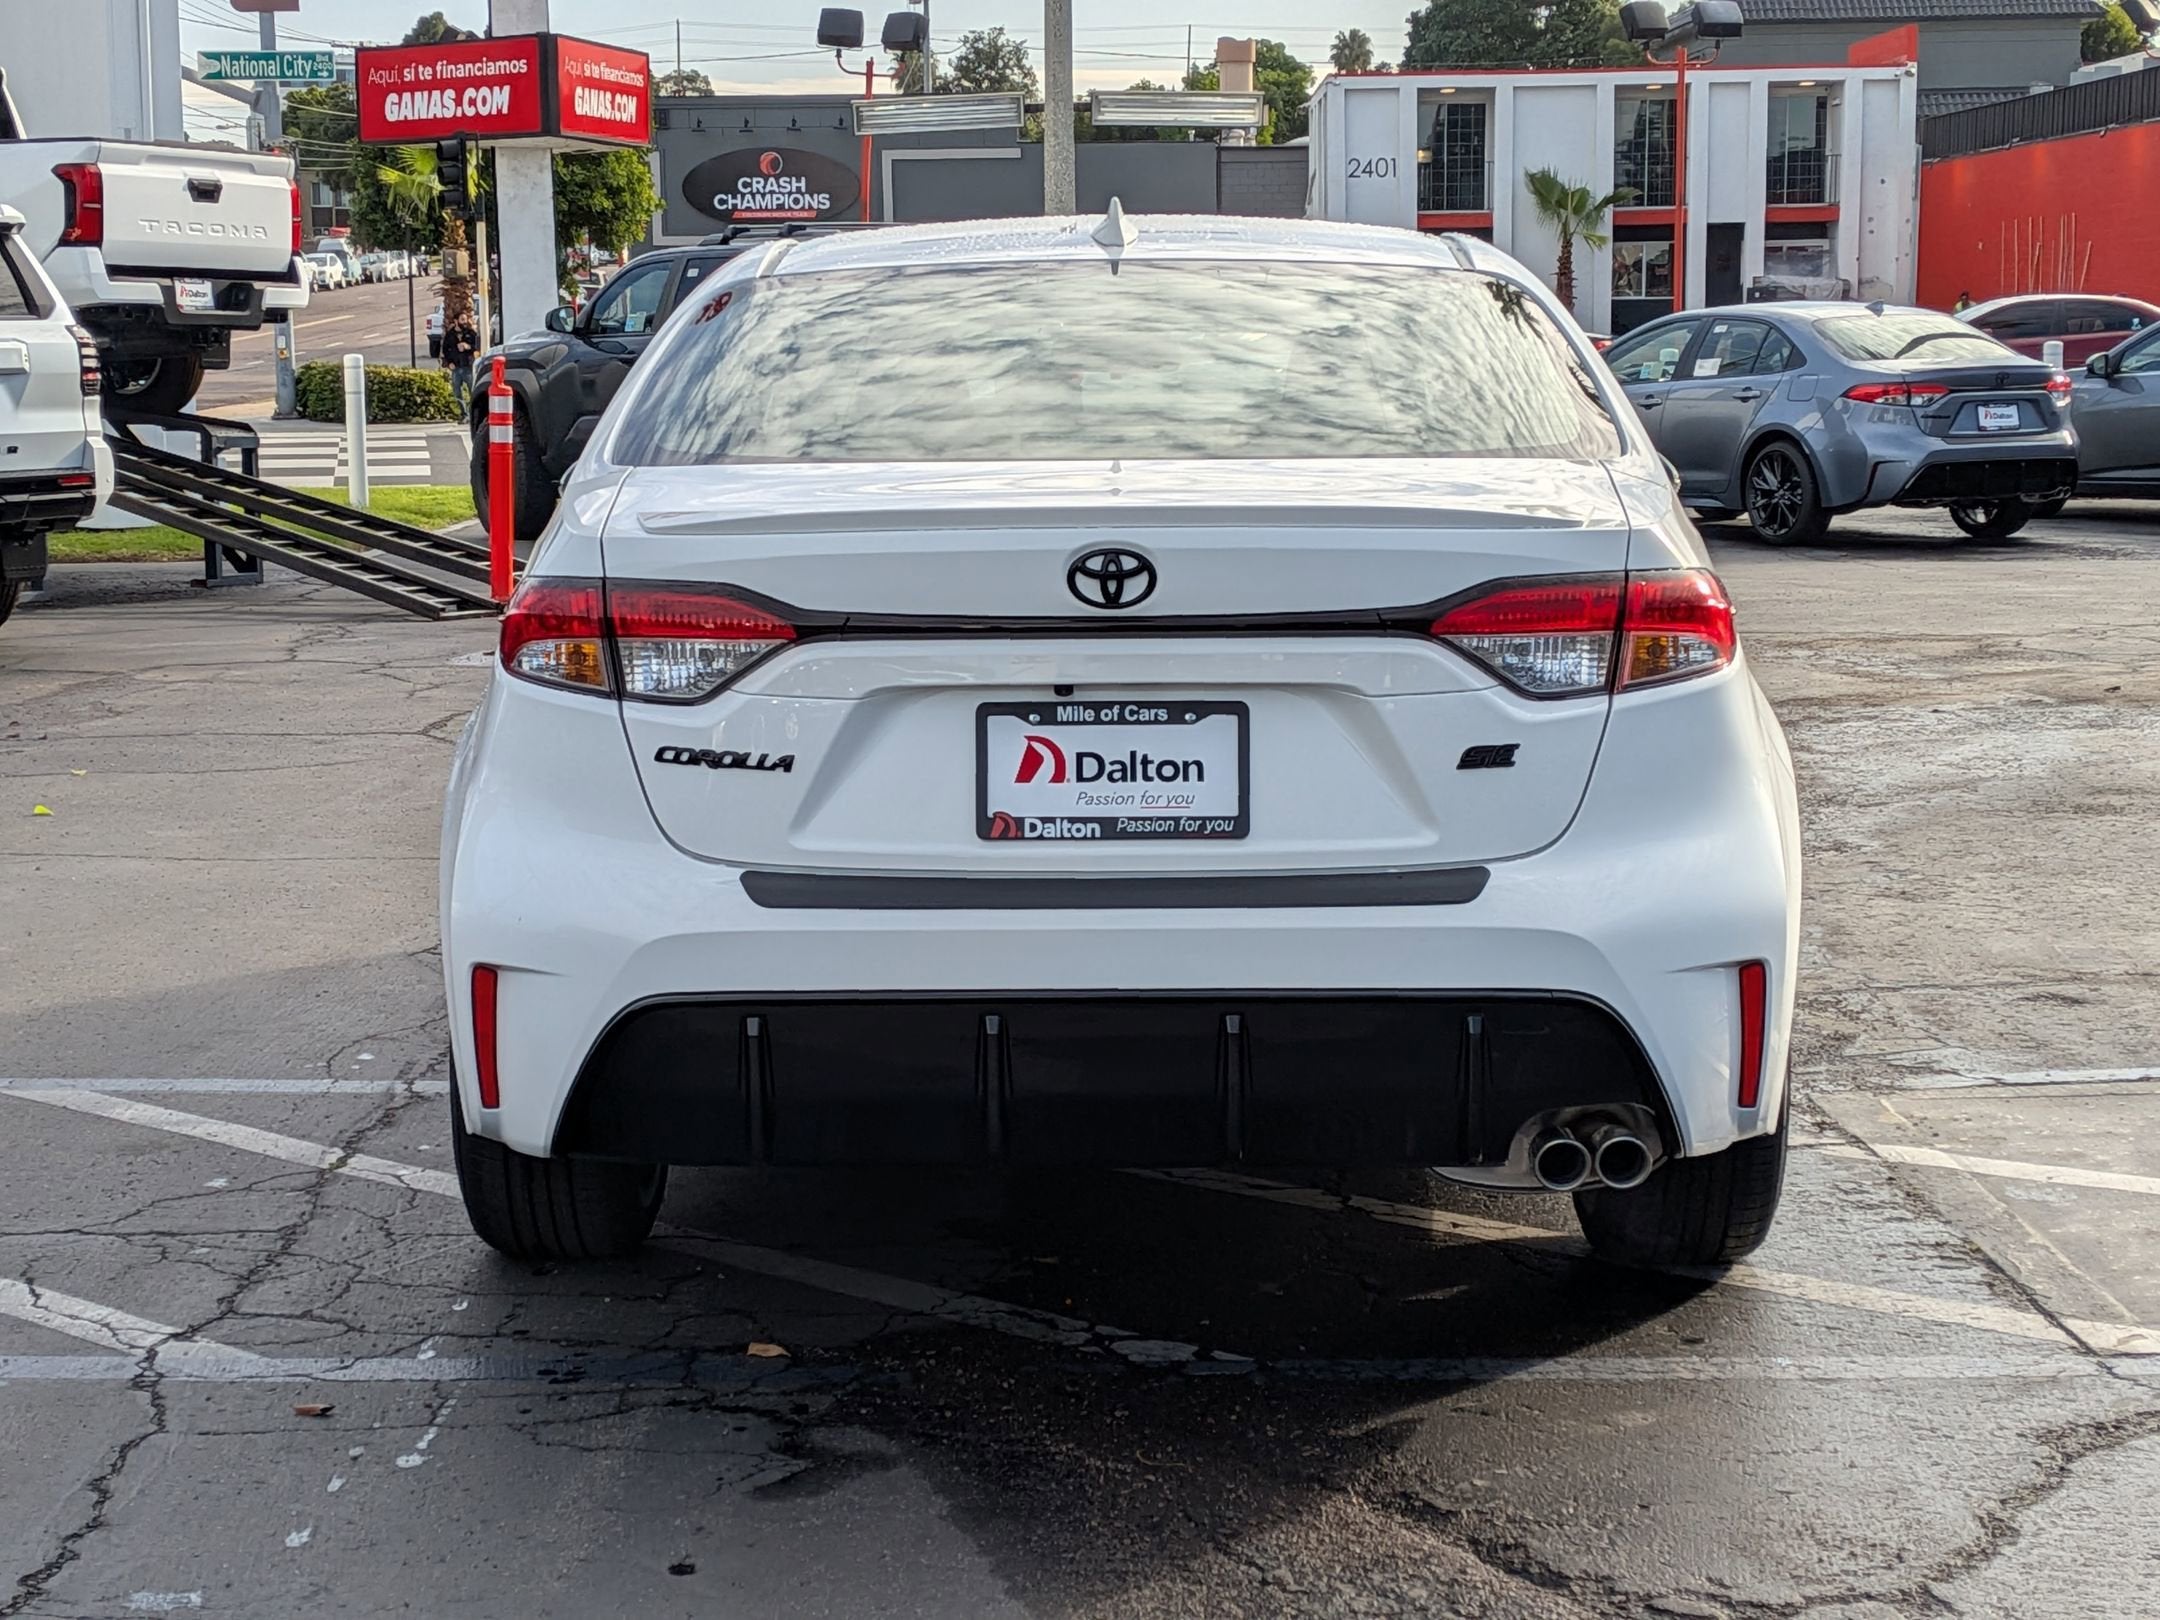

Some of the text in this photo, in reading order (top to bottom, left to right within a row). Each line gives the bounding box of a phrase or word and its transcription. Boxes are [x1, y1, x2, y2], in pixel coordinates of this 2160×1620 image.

[220, 53, 312, 78] National City
[312, 61, 333, 71] 2400
[403, 62, 415, 81] sí
[418, 63, 433, 80] te
[436, 57, 528, 79] financiamos
[384, 85, 511, 122] GANAS.COM
[574, 85, 637, 124] GANAS.COM
[1348, 157, 1397, 178] 2401
[737, 176, 806, 193] CRASH
[713, 193, 830, 210] CHAMPIONS
[138, 218, 268, 240] TACOMA
[1056, 705, 1169, 722] Mile of Cars
[654, 745, 796, 773] COROLLA
[1075, 750, 1205, 784] Dalton
[1076, 791, 1195, 808] Passion for you
[1024, 816, 1235, 839] Dalton Passion for you
